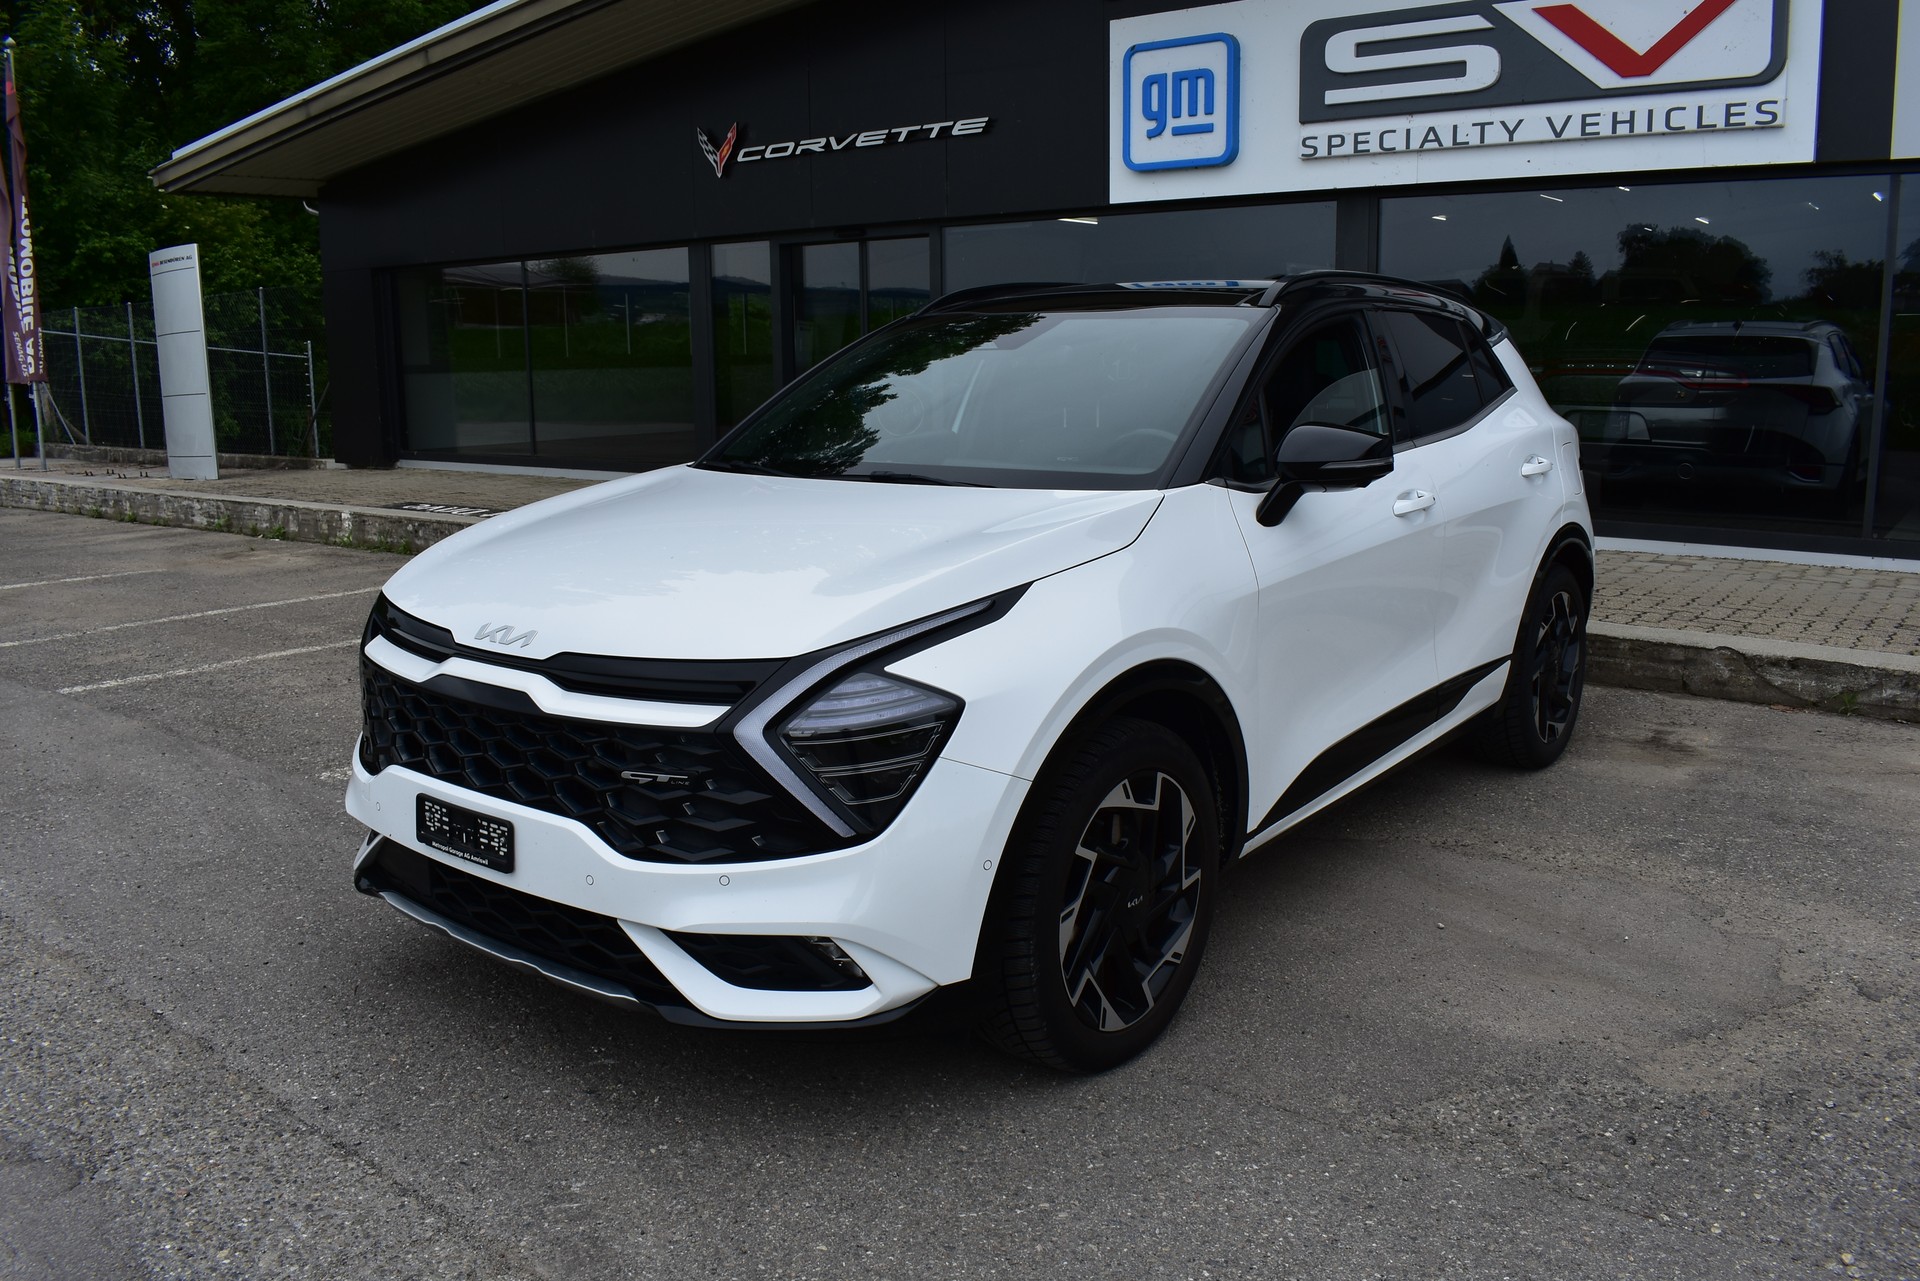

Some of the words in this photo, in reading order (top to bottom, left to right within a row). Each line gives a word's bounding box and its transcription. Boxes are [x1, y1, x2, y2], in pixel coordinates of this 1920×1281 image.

[1142, 68, 1214, 139] gm
[1301, 119, 1524, 159] SPECIALTY
[1546, 100, 1779, 139] VEHICLES
[737, 117, 989, 162] CORVETTE
